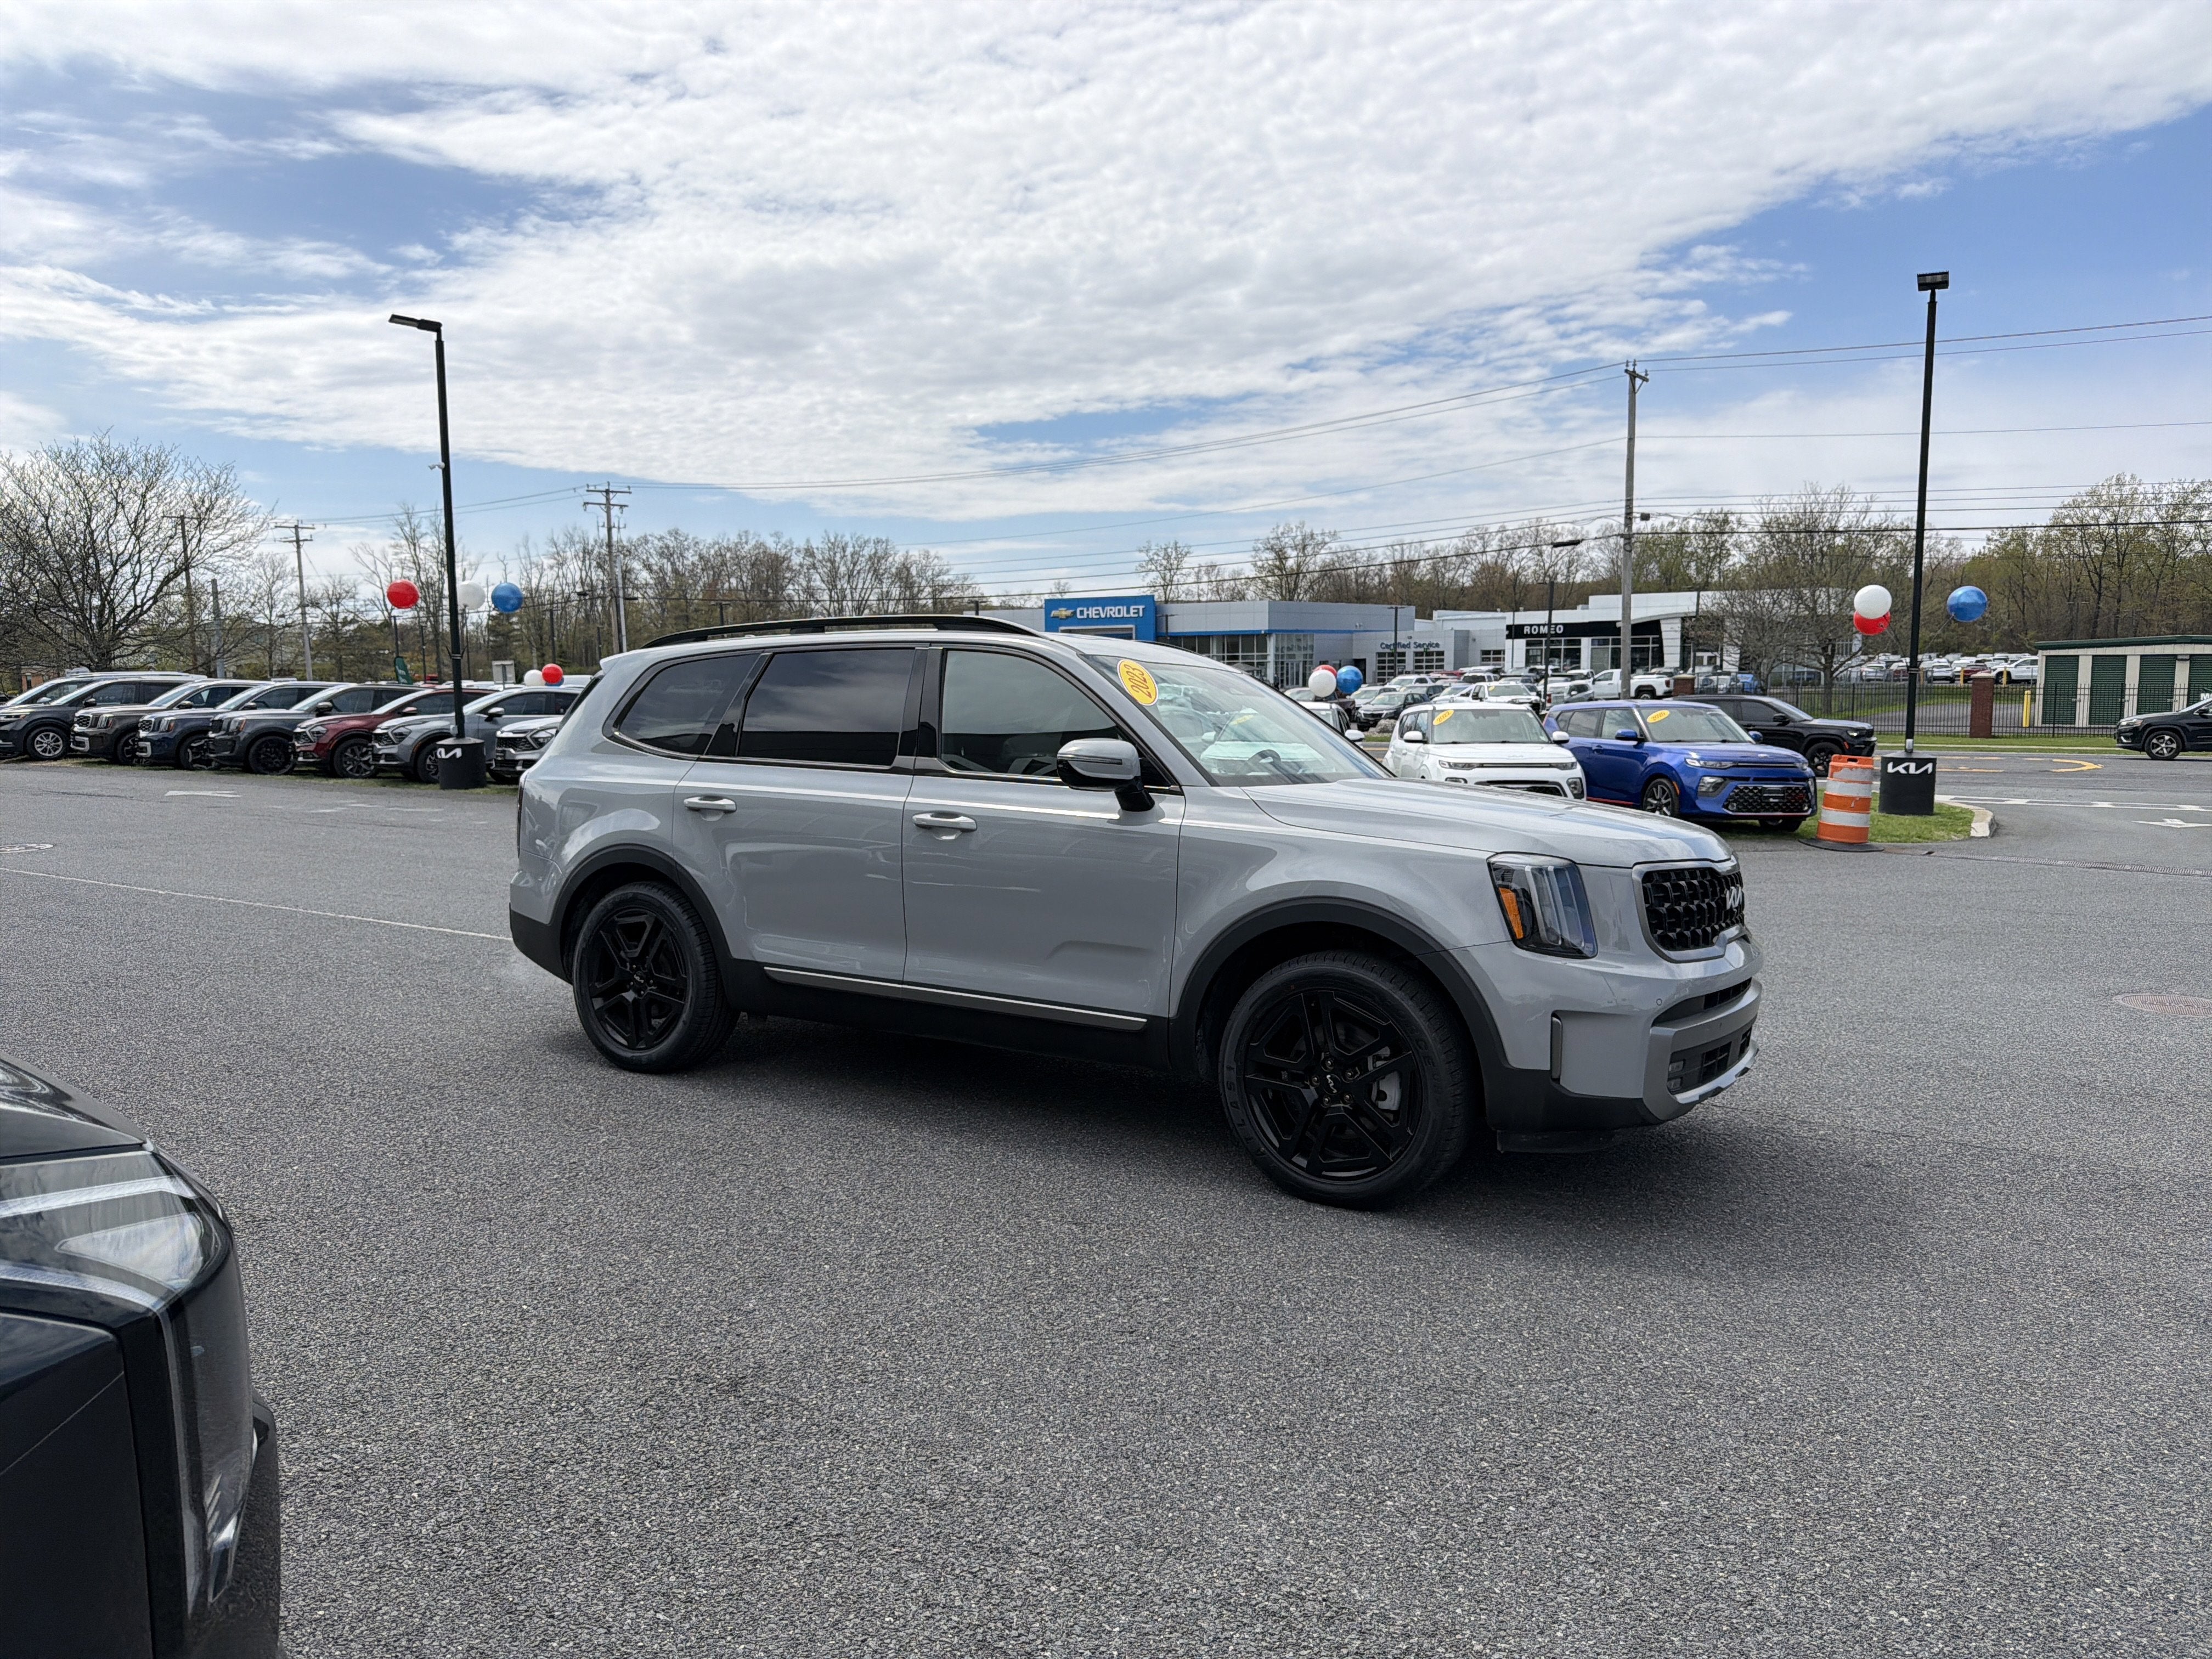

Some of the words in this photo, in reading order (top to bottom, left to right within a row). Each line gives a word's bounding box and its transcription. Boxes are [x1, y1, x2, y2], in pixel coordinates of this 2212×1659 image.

[1076, 605, 1145, 619] CHEVROLET
[1523, 624, 1564, 635] ROMEO
[1123, 663, 1152, 699] 2023
[1887, 761, 1933, 775] KIA
